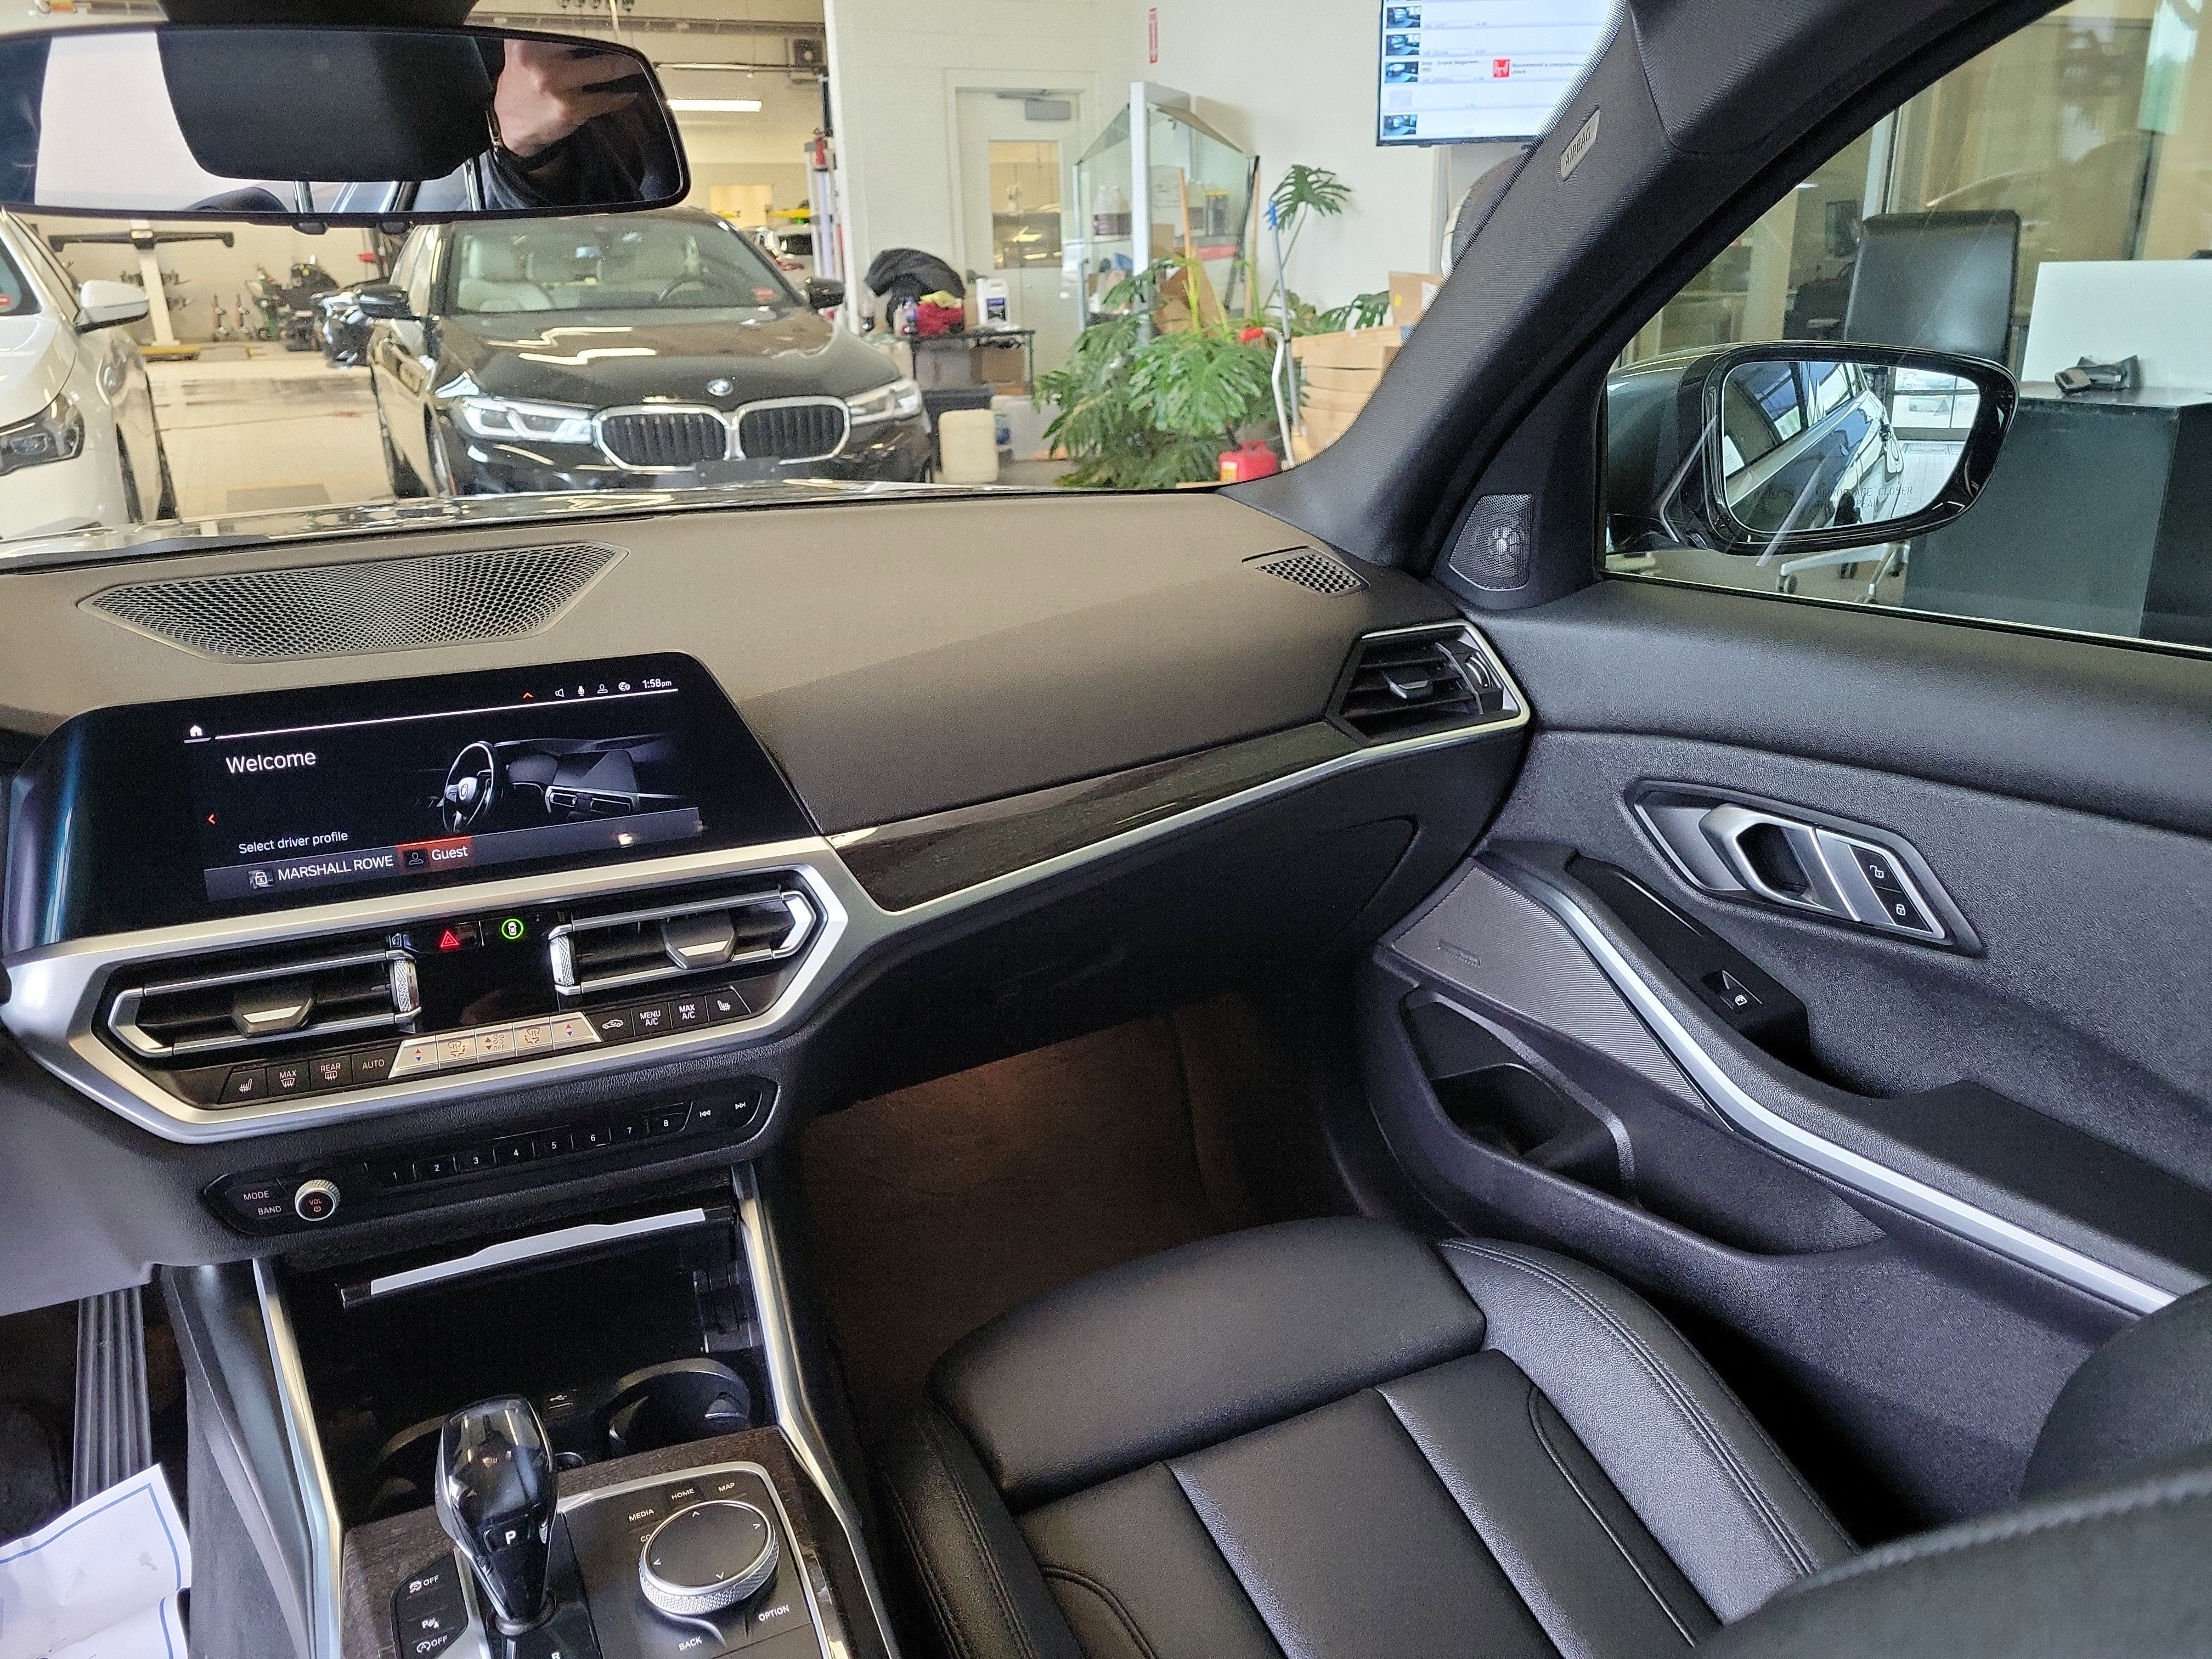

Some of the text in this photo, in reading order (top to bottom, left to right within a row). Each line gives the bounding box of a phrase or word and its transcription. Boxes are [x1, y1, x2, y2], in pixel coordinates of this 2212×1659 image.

[1565, 126, 1591, 169] AIRBAG
[1878, 486, 1913, 496] CLOSER
[642, 678, 672, 689] 1:58pm
[225, 752, 316, 774] Welcome
[239, 831, 348, 854] Select driver profile
[431, 845, 469, 861] Guest
[278, 855, 394, 881] MARSHALL ROWE
[679, 1003, 696, 1013] MAX
[640, 1009, 661, 1020] MENU
[682, 1011, 696, 1020] A/C
[645, 1018, 659, 1027] A/C
[320, 1062, 341, 1073] REAR
[362, 1059, 385, 1070] AUTO
[279, 1070, 297, 1079] MAX
[434, 1164, 440, 1172] 2
[243, 1190, 270, 1201] MODE
[258, 1205, 282, 1215] BAND
[718, 1482, 735, 1492] MAP
[671, 1488, 695, 1500] HOME
[629, 1509, 654, 1521] MEDIA
[505, 1530, 516, 1545] P
[640, 1534, 651, 1542] CO
[423, 1575, 439, 1587] OFF
[758, 1605, 790, 1622] OPTION
[431, 1635, 448, 1647] OFF
[679, 1635, 702, 1651] BACK
